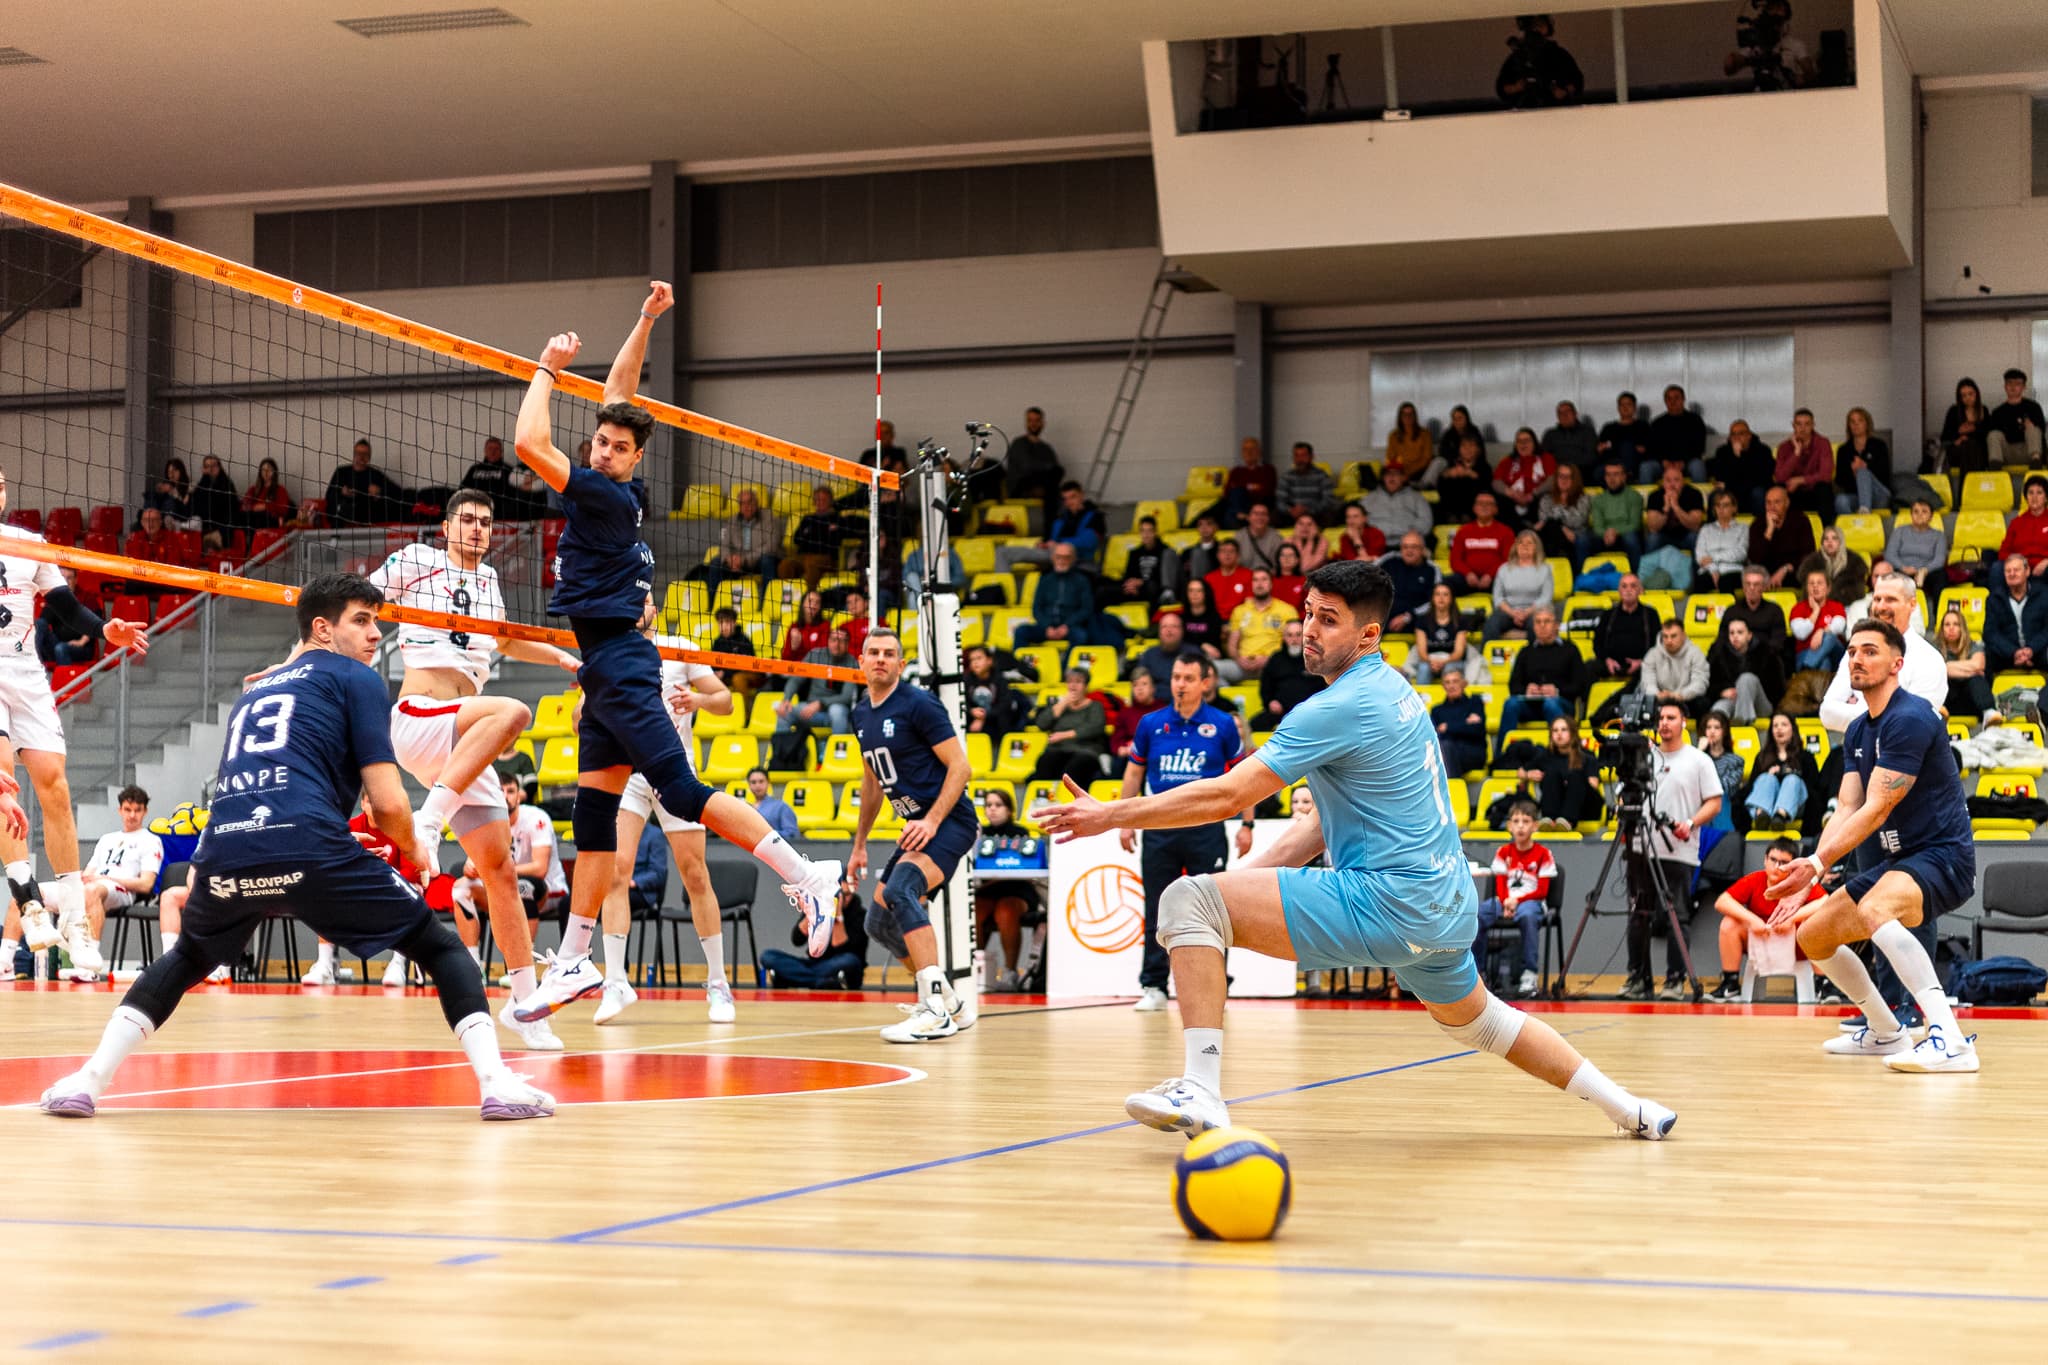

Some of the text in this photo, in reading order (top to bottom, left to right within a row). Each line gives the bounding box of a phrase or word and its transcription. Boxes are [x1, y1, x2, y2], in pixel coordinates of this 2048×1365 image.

[246, 663, 314, 694] RUBAČ
[227, 694, 295, 761] 13
[1159, 748, 1207, 773] niké
[981, 839, 994, 856] 3
[1021, 839, 1036, 856] 3
[239, 871, 304, 890] SLOVPAP
[242, 888, 286, 897] SLOVAKIA
